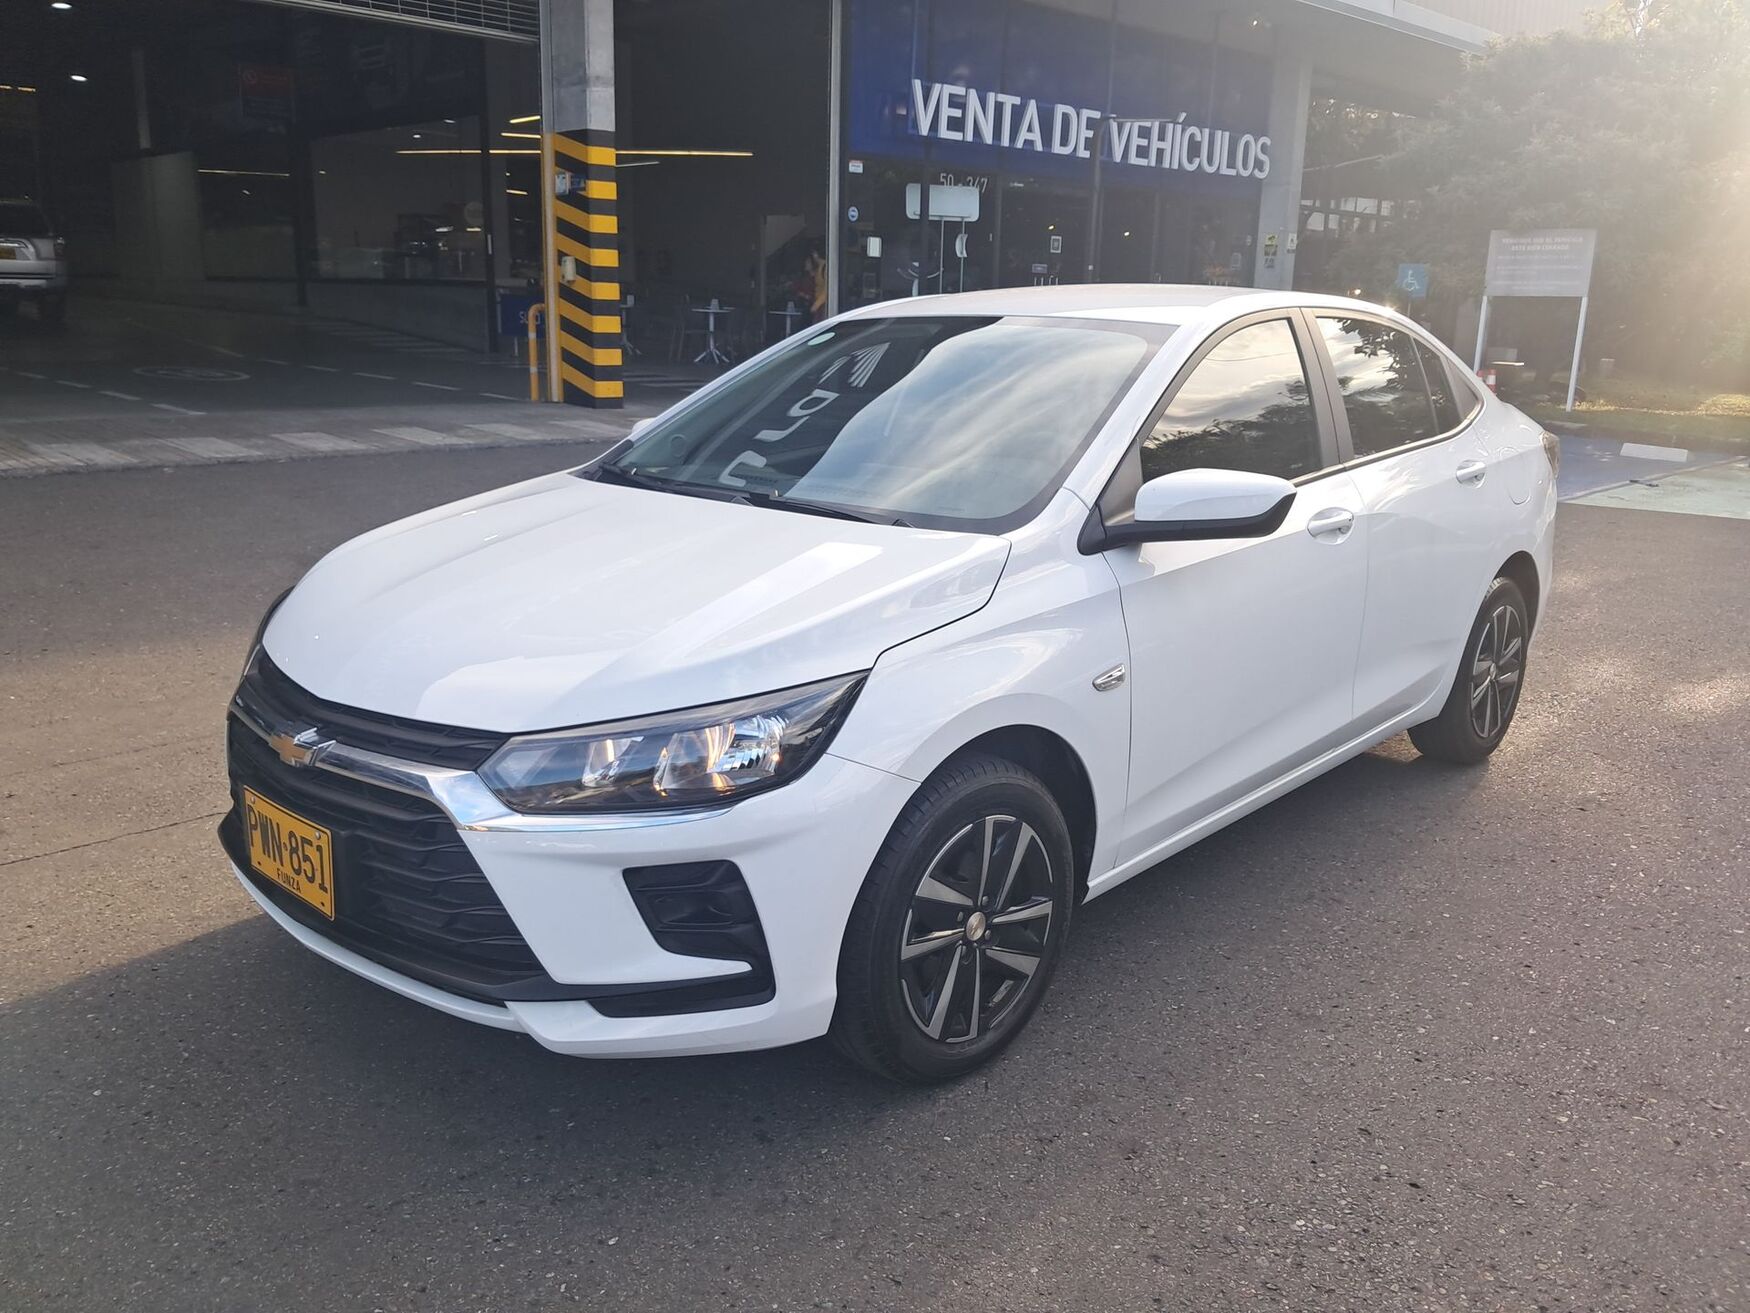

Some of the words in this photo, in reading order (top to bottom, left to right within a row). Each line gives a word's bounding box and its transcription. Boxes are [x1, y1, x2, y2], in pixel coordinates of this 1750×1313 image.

[911, 78, 1043, 152] VENTA
[1051, 103, 1101, 159] DE
[1108, 112, 1272, 180] VEHÍCULOS
[276, 867, 302, 895] FUNZA
